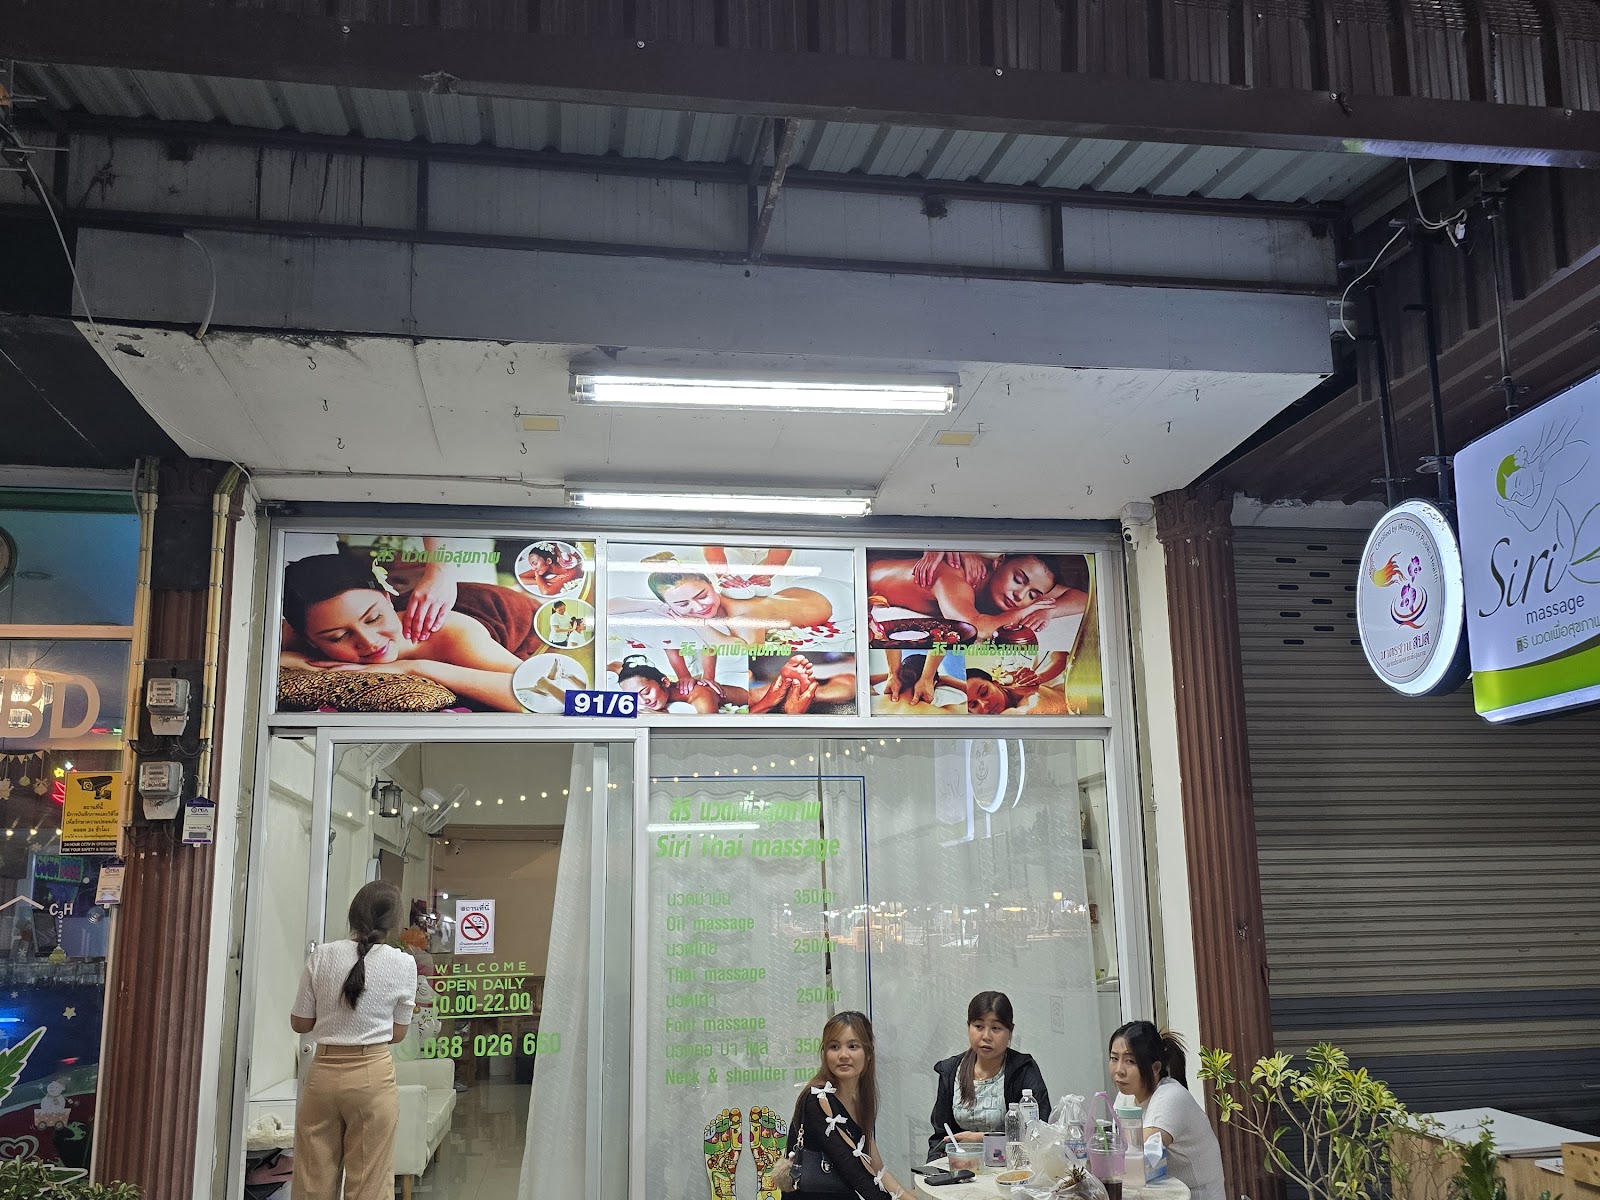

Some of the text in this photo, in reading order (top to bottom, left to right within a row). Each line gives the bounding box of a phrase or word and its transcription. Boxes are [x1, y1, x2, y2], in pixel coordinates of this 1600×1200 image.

[401, 544, 501, 568] นวดเพื่อสุขภาพ
[1478, 537, 1568, 617] Siri
[1526, 595, 1585, 625] massage
[952, 638, 1040, 660] นวดเพื่อสุขภาพ
[574, 693, 634, 714] 91/6
[655, 834, 840, 862] Siri Thai massage
[794, 889, 838, 904] 350/hr
[667, 916, 754, 932] Oil massage
[667, 934, 838, 956] นวดไทย 250/hr
[435, 962, 527, 974] WELCOME
[668, 967, 766, 983] Thai massage
[435, 978, 525, 992] OPEN DAILY
[796, 987, 841, 1004] 250/hr
[432, 992, 531, 1014] 10.00-22.00
[666, 1017, 766, 1033] Foot massage
[424, 1036, 463, 1059] 038
[474, 1033, 513, 1057] 026
[666, 1069, 700, 1084] Neck
[708, 1067, 718, 1083] &
[726, 1066, 787, 1082] shoulder
